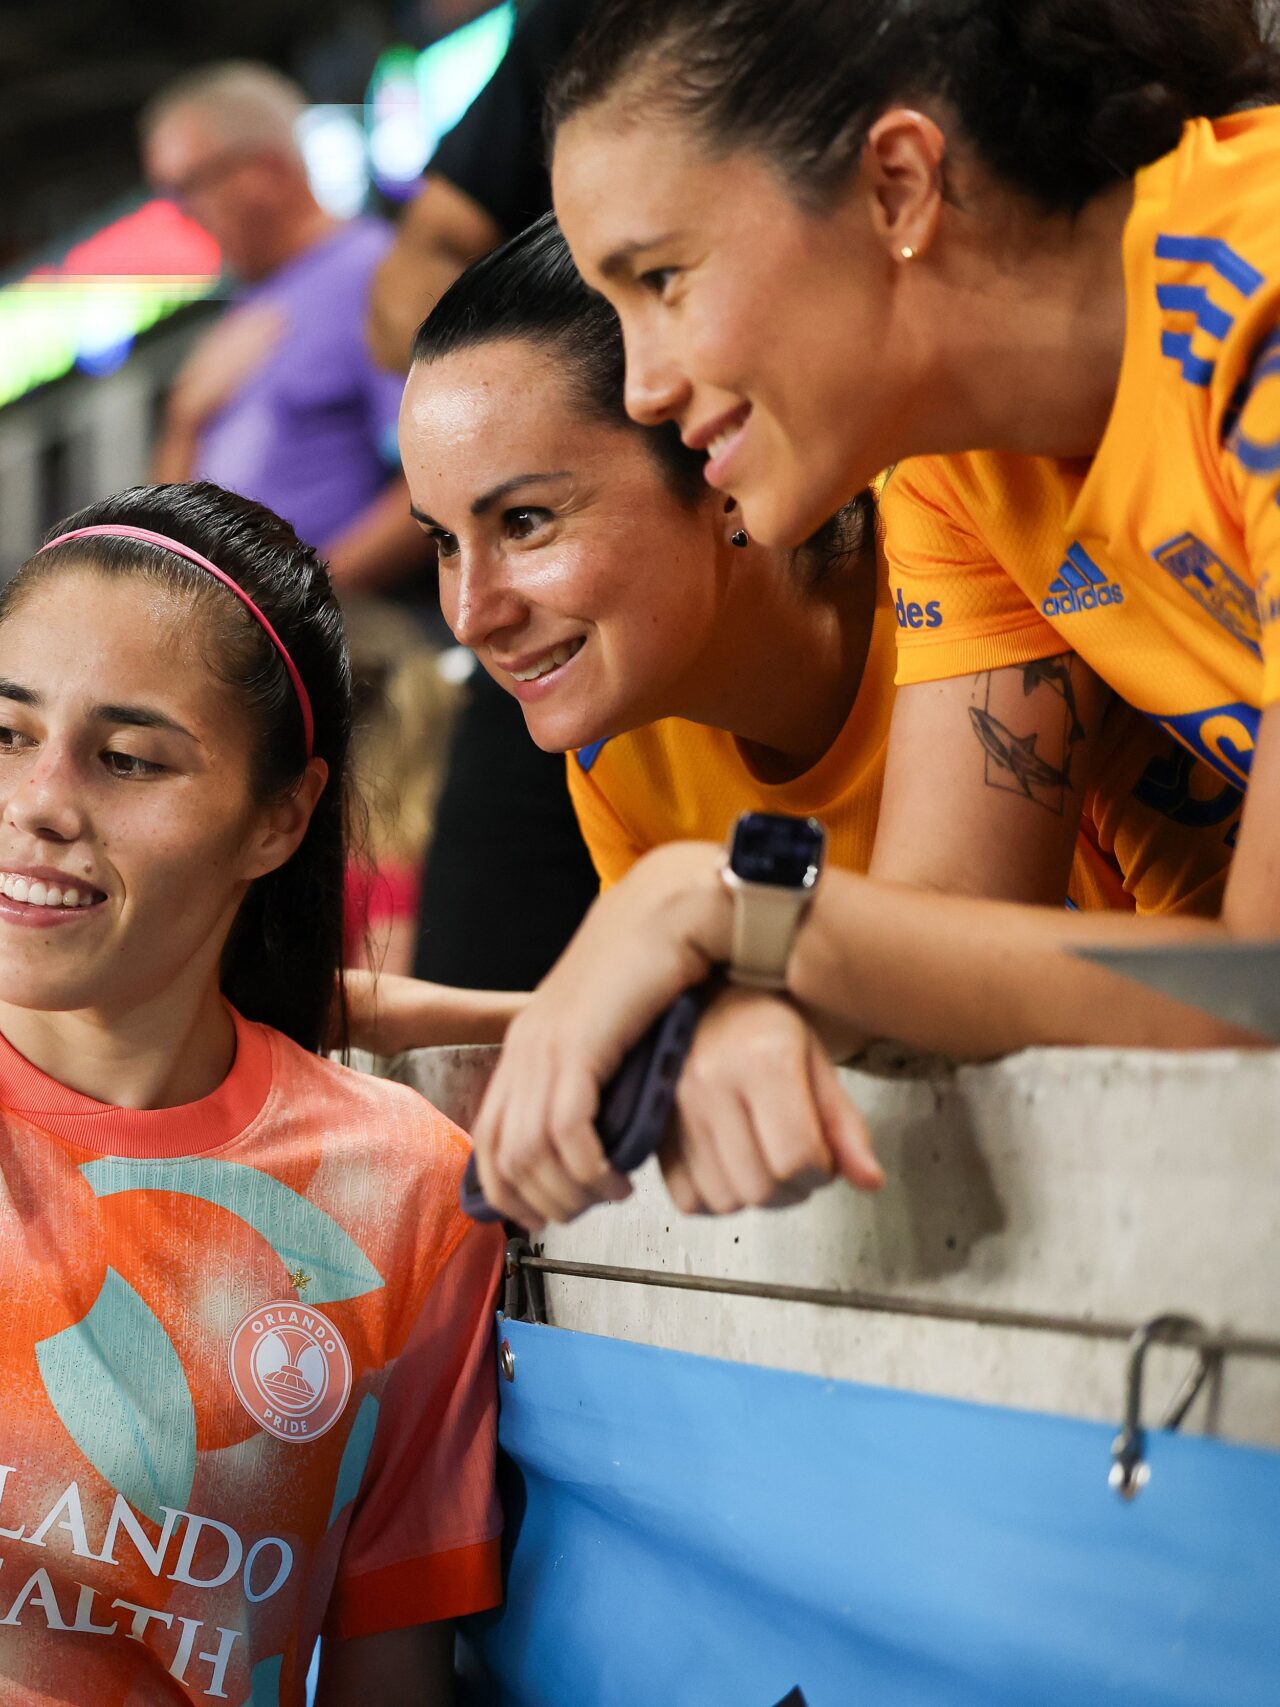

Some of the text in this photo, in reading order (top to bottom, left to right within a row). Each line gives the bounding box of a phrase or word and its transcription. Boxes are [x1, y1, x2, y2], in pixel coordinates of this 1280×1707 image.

[1042, 584, 1124, 616] adidas
[251, 1311, 336, 1353] ORLANDO
[263, 1408, 308, 1433] PRIDE
